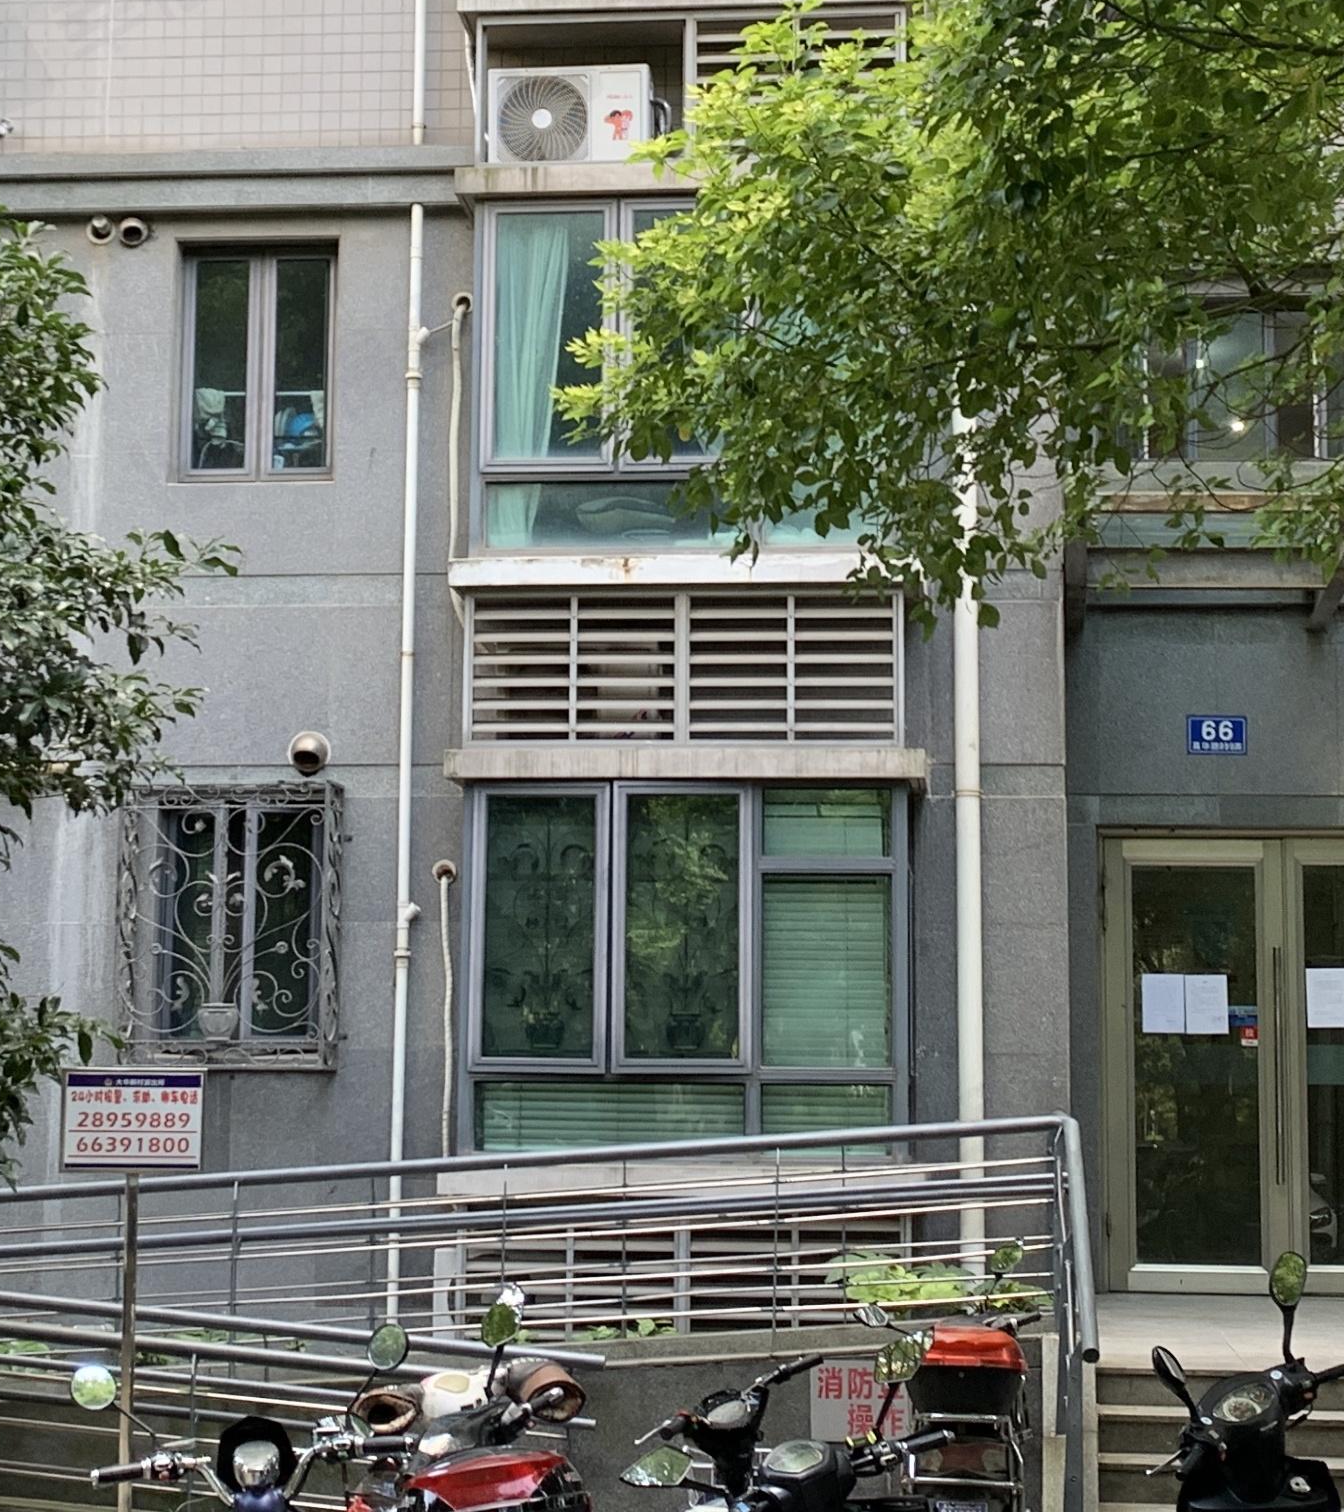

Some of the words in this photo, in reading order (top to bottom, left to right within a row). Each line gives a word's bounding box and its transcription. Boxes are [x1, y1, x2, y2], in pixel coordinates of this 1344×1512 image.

[1201, 720, 1234, 741] 66
[77, 1111, 191, 1129] 28959889
[76, 1136, 190, 1153] 66391800
[847, 1403, 905, 1437] 操作
